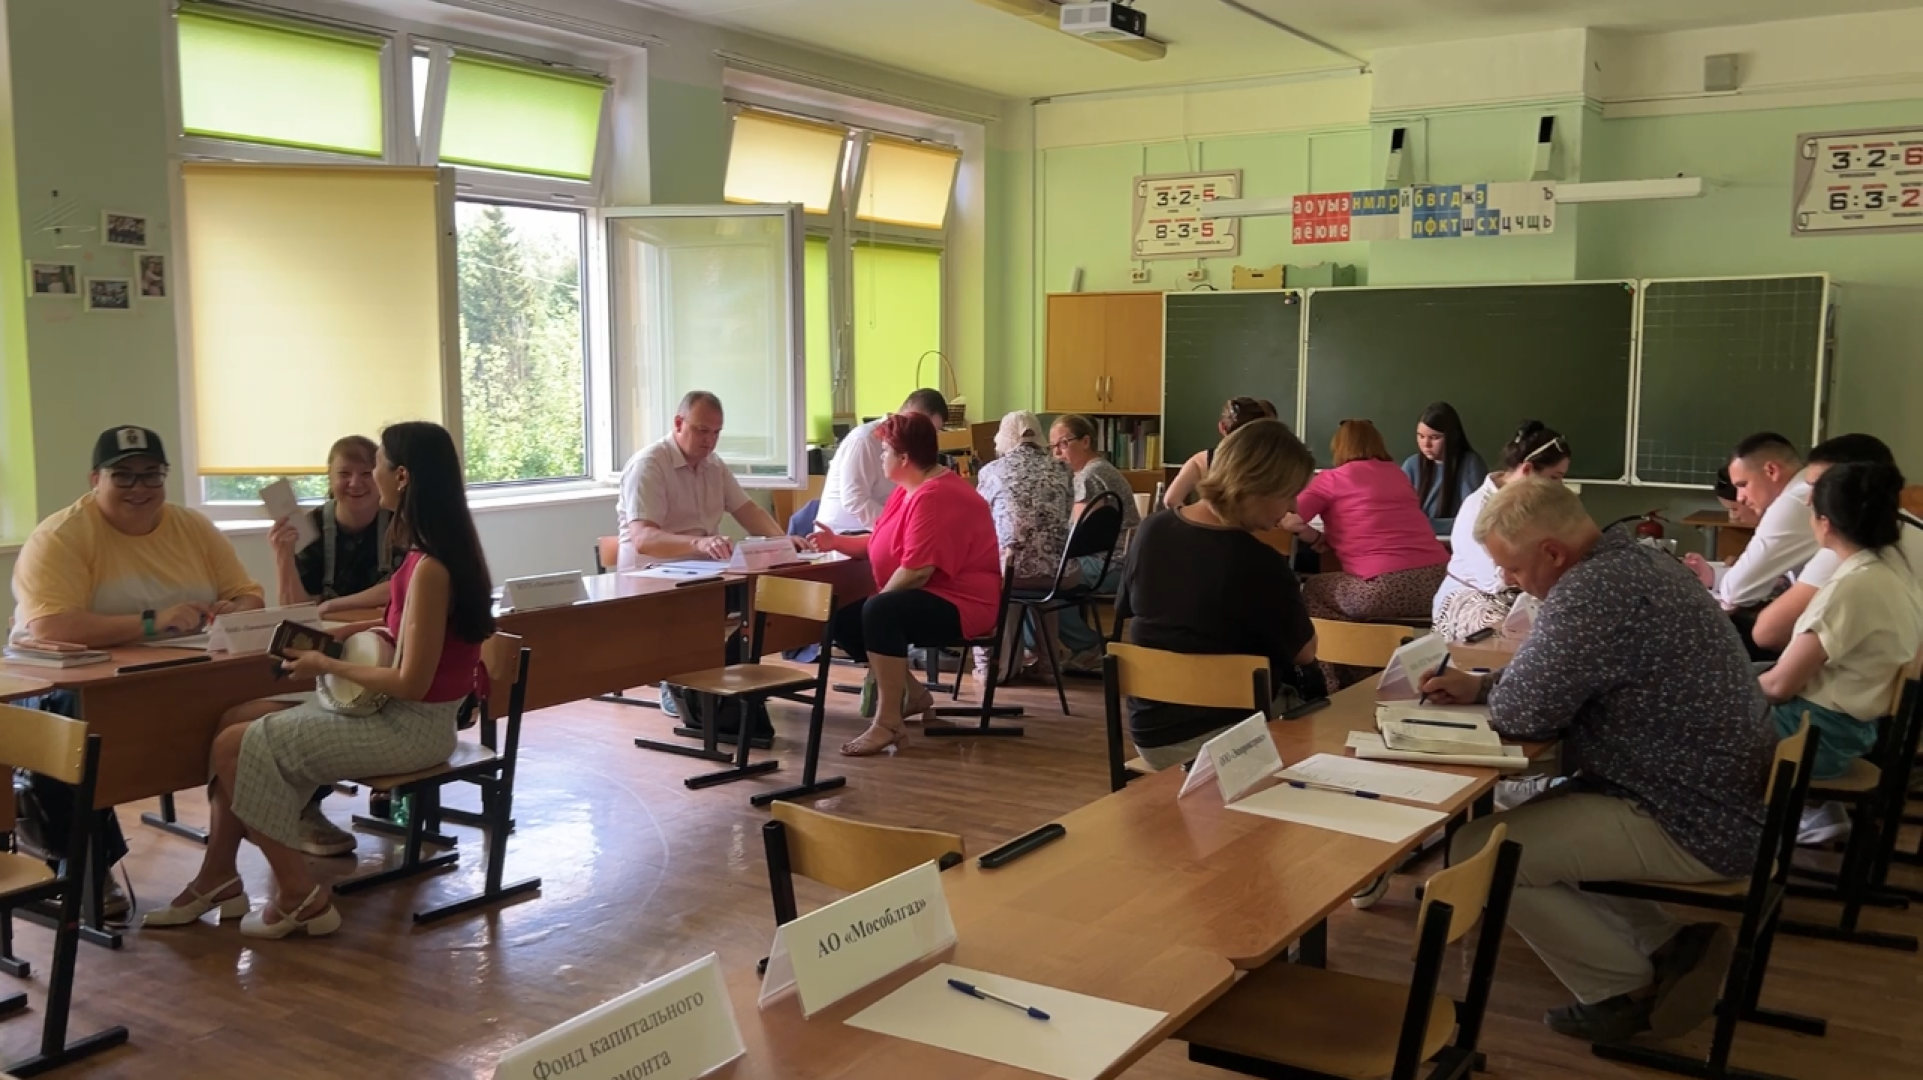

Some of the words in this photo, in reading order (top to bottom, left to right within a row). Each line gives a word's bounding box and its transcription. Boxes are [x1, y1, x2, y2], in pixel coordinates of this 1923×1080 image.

[818, 932, 841, 958] АО
[844, 899, 926, 945] «Мособлгаз»
[532, 1047, 588, 1080] Фонд
[589, 991, 704, 1057] капитального
[614, 1050, 672, 1080] монта
